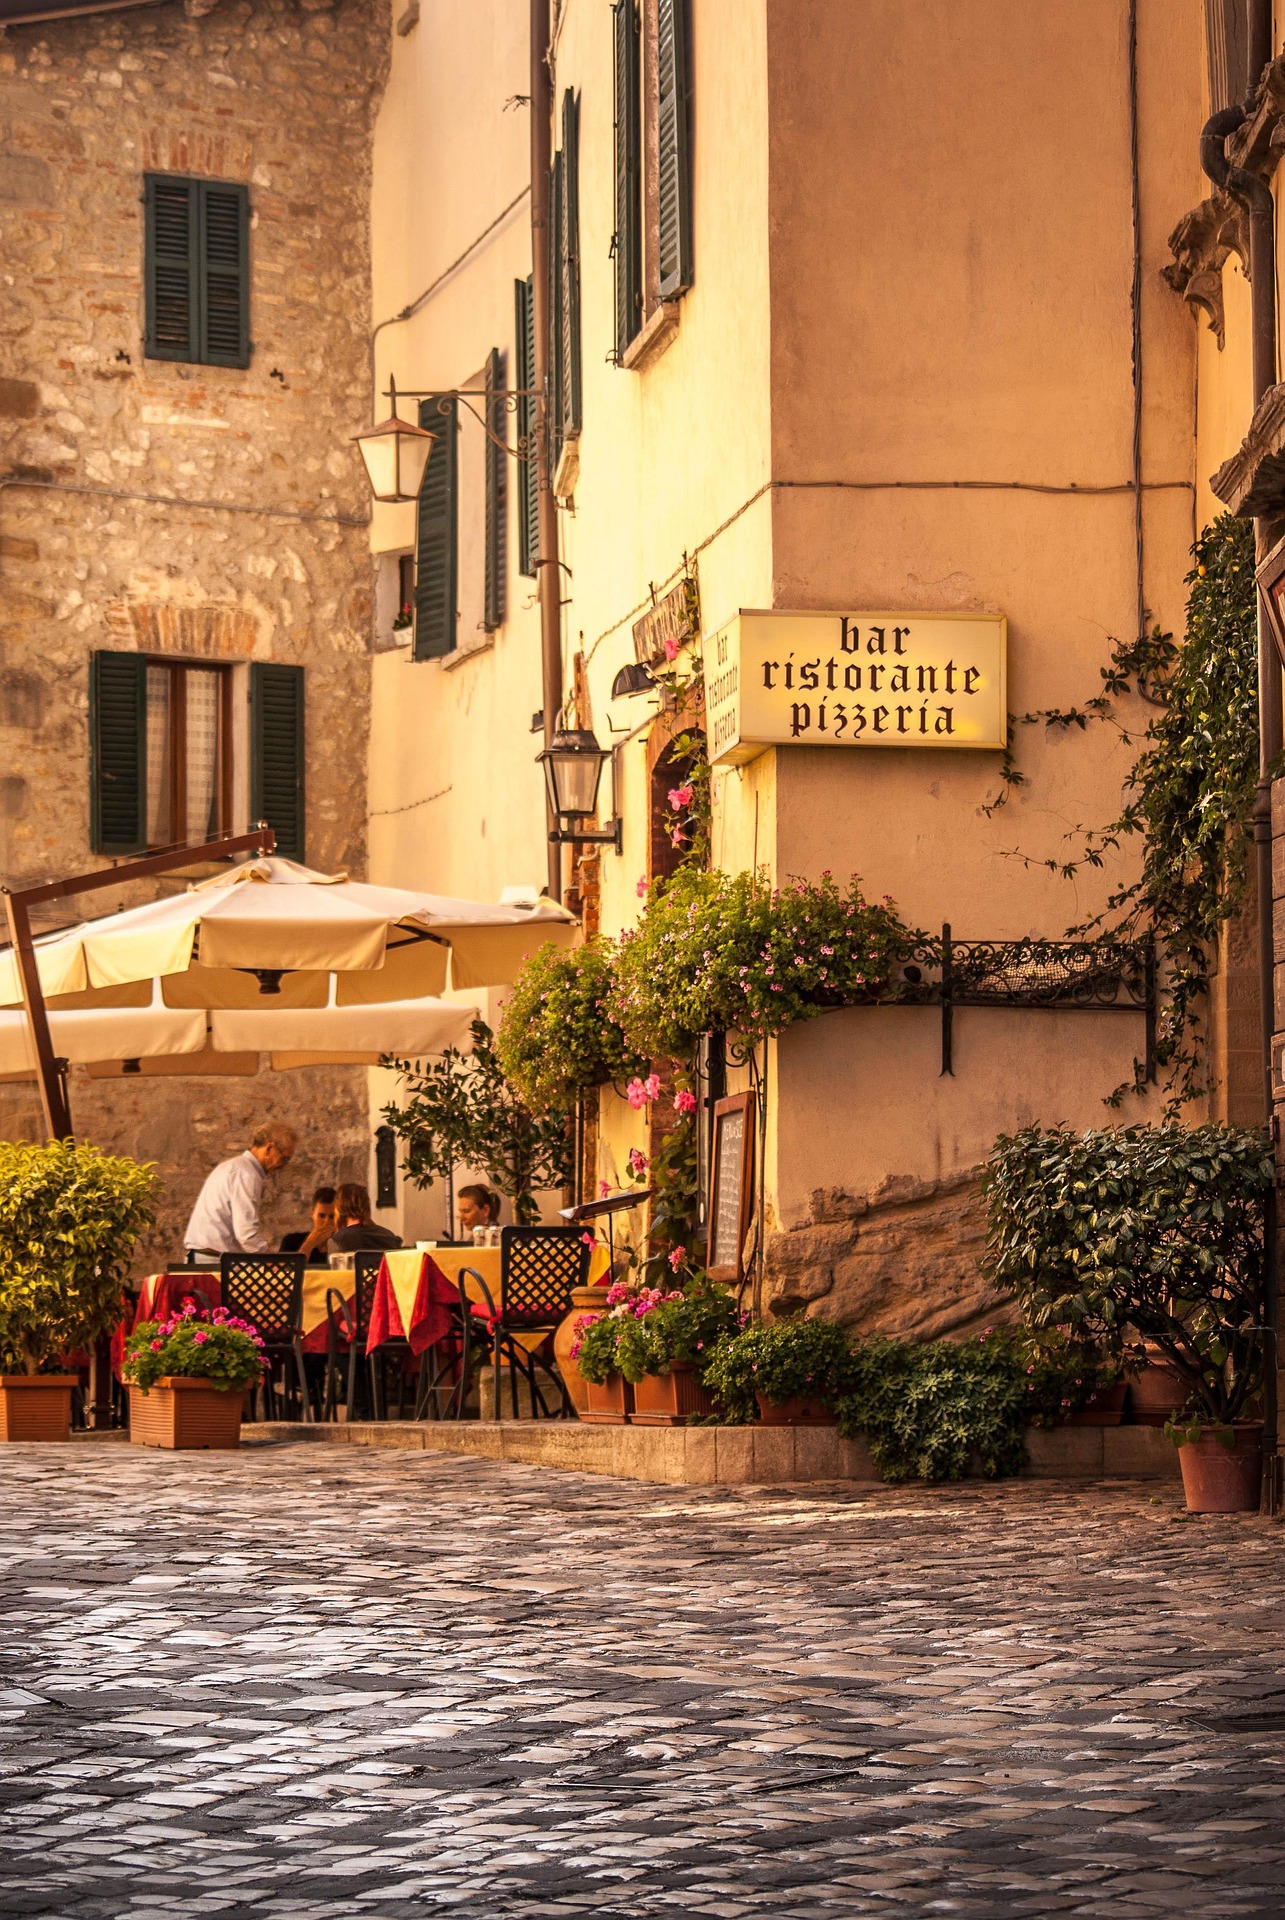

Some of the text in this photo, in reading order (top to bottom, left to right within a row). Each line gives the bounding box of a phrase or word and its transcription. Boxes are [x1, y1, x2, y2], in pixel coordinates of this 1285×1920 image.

[839, 616, 911, 656] bar
[761, 652, 981, 696] ristorante
[789, 695, 956, 739] pizzeria
